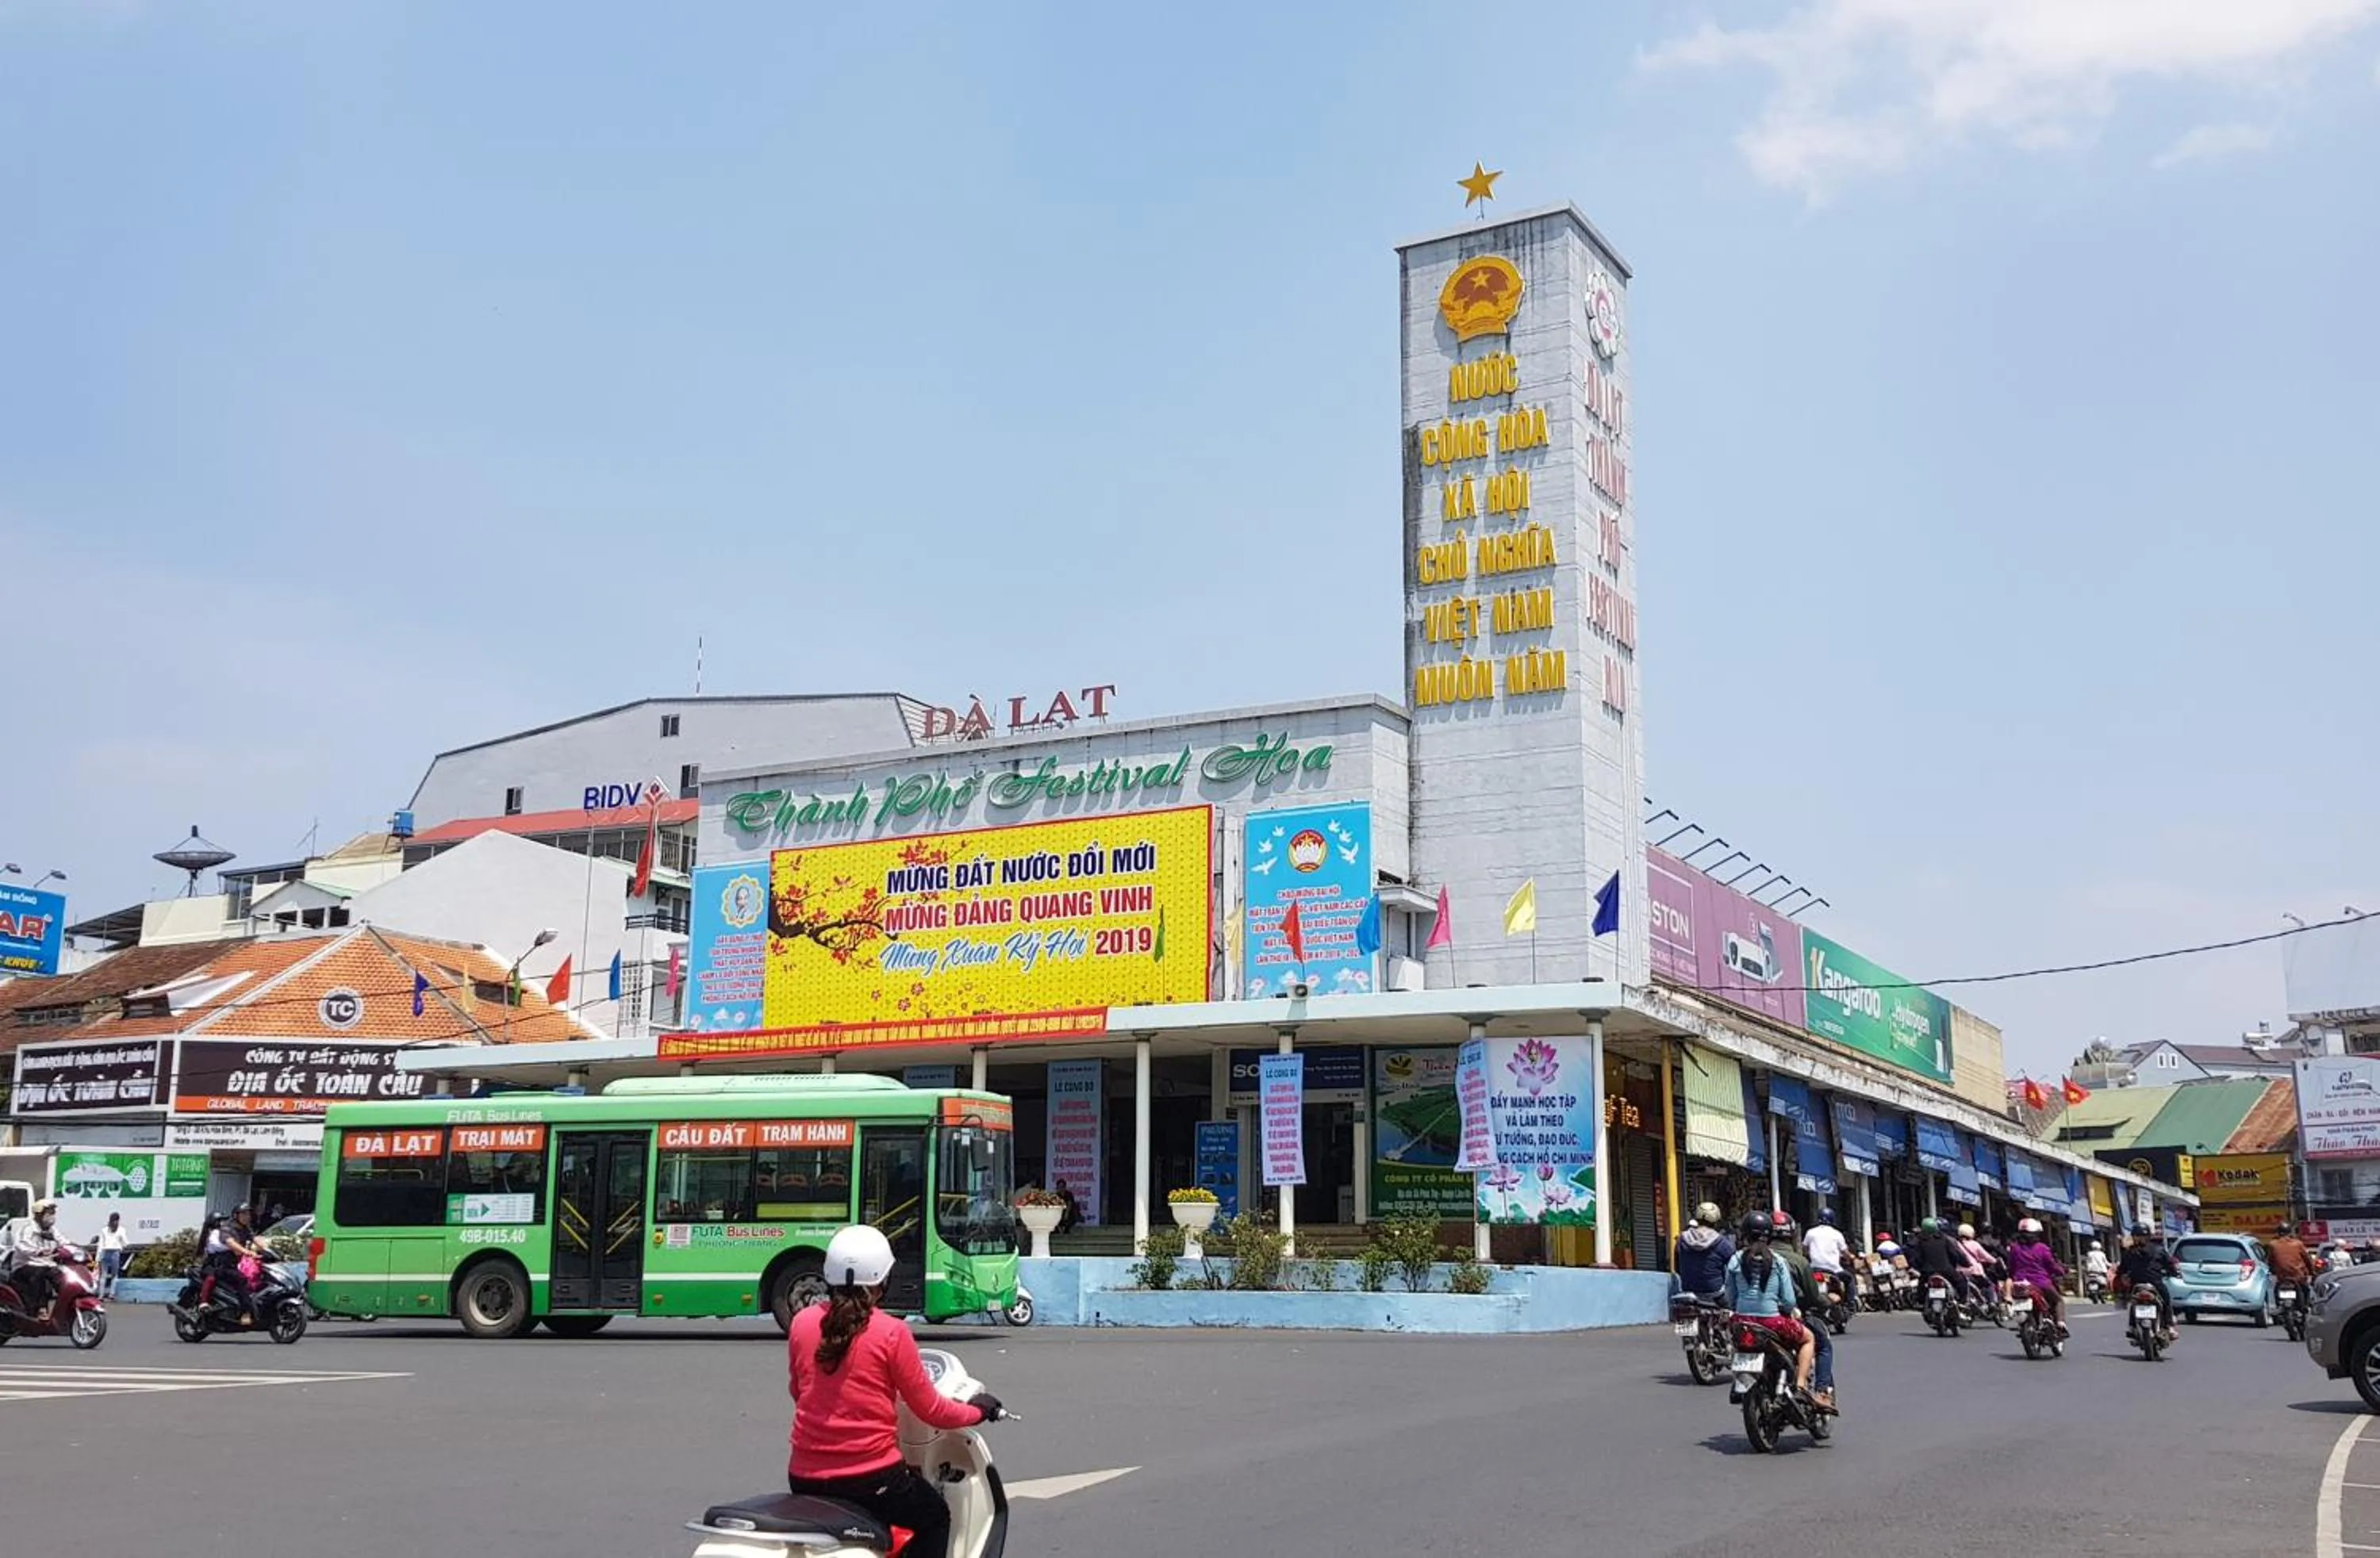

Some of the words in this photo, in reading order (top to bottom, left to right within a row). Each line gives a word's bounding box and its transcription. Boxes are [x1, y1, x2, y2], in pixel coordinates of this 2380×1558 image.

[1450, 351, 1518, 403] NƯỚC
[1420, 419, 1488, 471] CỘNG
[1498, 403, 1549, 455] HÒA
[1442, 472, 1477, 521] XÃ
[1486, 466, 1530, 520] HỘI
[1417, 528, 1468, 585] CHỦ
[1476, 520, 1558, 577] NGHĨA
[1424, 595, 1480, 649] VIỆT
[1492, 586, 1554, 634] NAM
[1415, 655, 1495, 708] MUÔN
[1506, 645, 1567, 696] NĂM
[583, 782, 643, 810] BIDV
[726, 779, 872, 835] Thành
[873, 768, 988, 827] Phố
[988, 741, 1195, 809] Festival
[1200, 730, 1335, 786] Hoa
[886, 864, 949, 894] MỪNG
[955, 853, 996, 888] ĐẤT
[1001, 851, 1061, 884] NƯỚC
[1067, 841, 1105, 878] ĐỔI
[1111, 841, 1155, 873] MỚI
[884, 902, 948, 933] MỪNG
[953, 893, 1012, 927] ĐẢNG
[1019, 891, 1092, 924] QUANG
[1100, 886, 1154, 914] VINH
[1649, 900, 1689, 940] STON
[879, 939, 939, 977] Mừng
[941, 939, 999, 973] Xuân
[1004, 929, 1044, 975] Kỷ
[1045, 927, 1088, 957] Hợi
[1095, 927, 1153, 956] 2019
[1810, 946, 1881, 1019] Kangaroo
[328, 1001, 355, 1016] TC
[246, 1047, 283, 1065] CÔNG
[288, 1050, 305, 1065] TY
[340, 1050, 378, 1069] ĐỘNG
[228, 1071, 268, 1096] ĐỊA
[274, 1065, 306, 1093] ỐC
[315, 1069, 373, 1095] TOÀN
[207, 1097, 247, 1111] GLOBAL
[255, 1096, 283, 1111] LAND
[1491, 1091, 1508, 1108] ĐẨY
[1510, 1096, 1536, 1112] MẠNH
[1538, 1096, 1557, 1112] HỌC
[1559, 1093, 1577, 1112] TẬP
[447, 1111, 482, 1123] FUTA
[1506, 1111, 1517, 1126] VÀ
[1519, 1111, 1537, 1126] LÀM
[1540, 1115, 1564, 1127] THEO
[355, 1133, 385, 1153] ĐÀ
[393, 1135, 436, 1156] LẠT
[458, 1130, 496, 1149] TRẠI
[500, 1126, 536, 1145] MÁT
[666, 1122, 703, 1145] CẦU
[708, 1122, 747, 1145] ĐẤT
[762, 1125, 803, 1145] TRẠM
[807, 1120, 846, 1142] HÀNH
[1510, 1151, 1535, 1164] CÁCH
[1537, 1146, 1549, 1164] HỒ
[1552, 1150, 1567, 1164] CHÍ
[1570, 1151, 1594, 1164] MINH
[692, 1226, 723, 1238] FUTA
[727, 1226, 750, 1238] Bus
[752, 1226, 785, 1238] Lines
